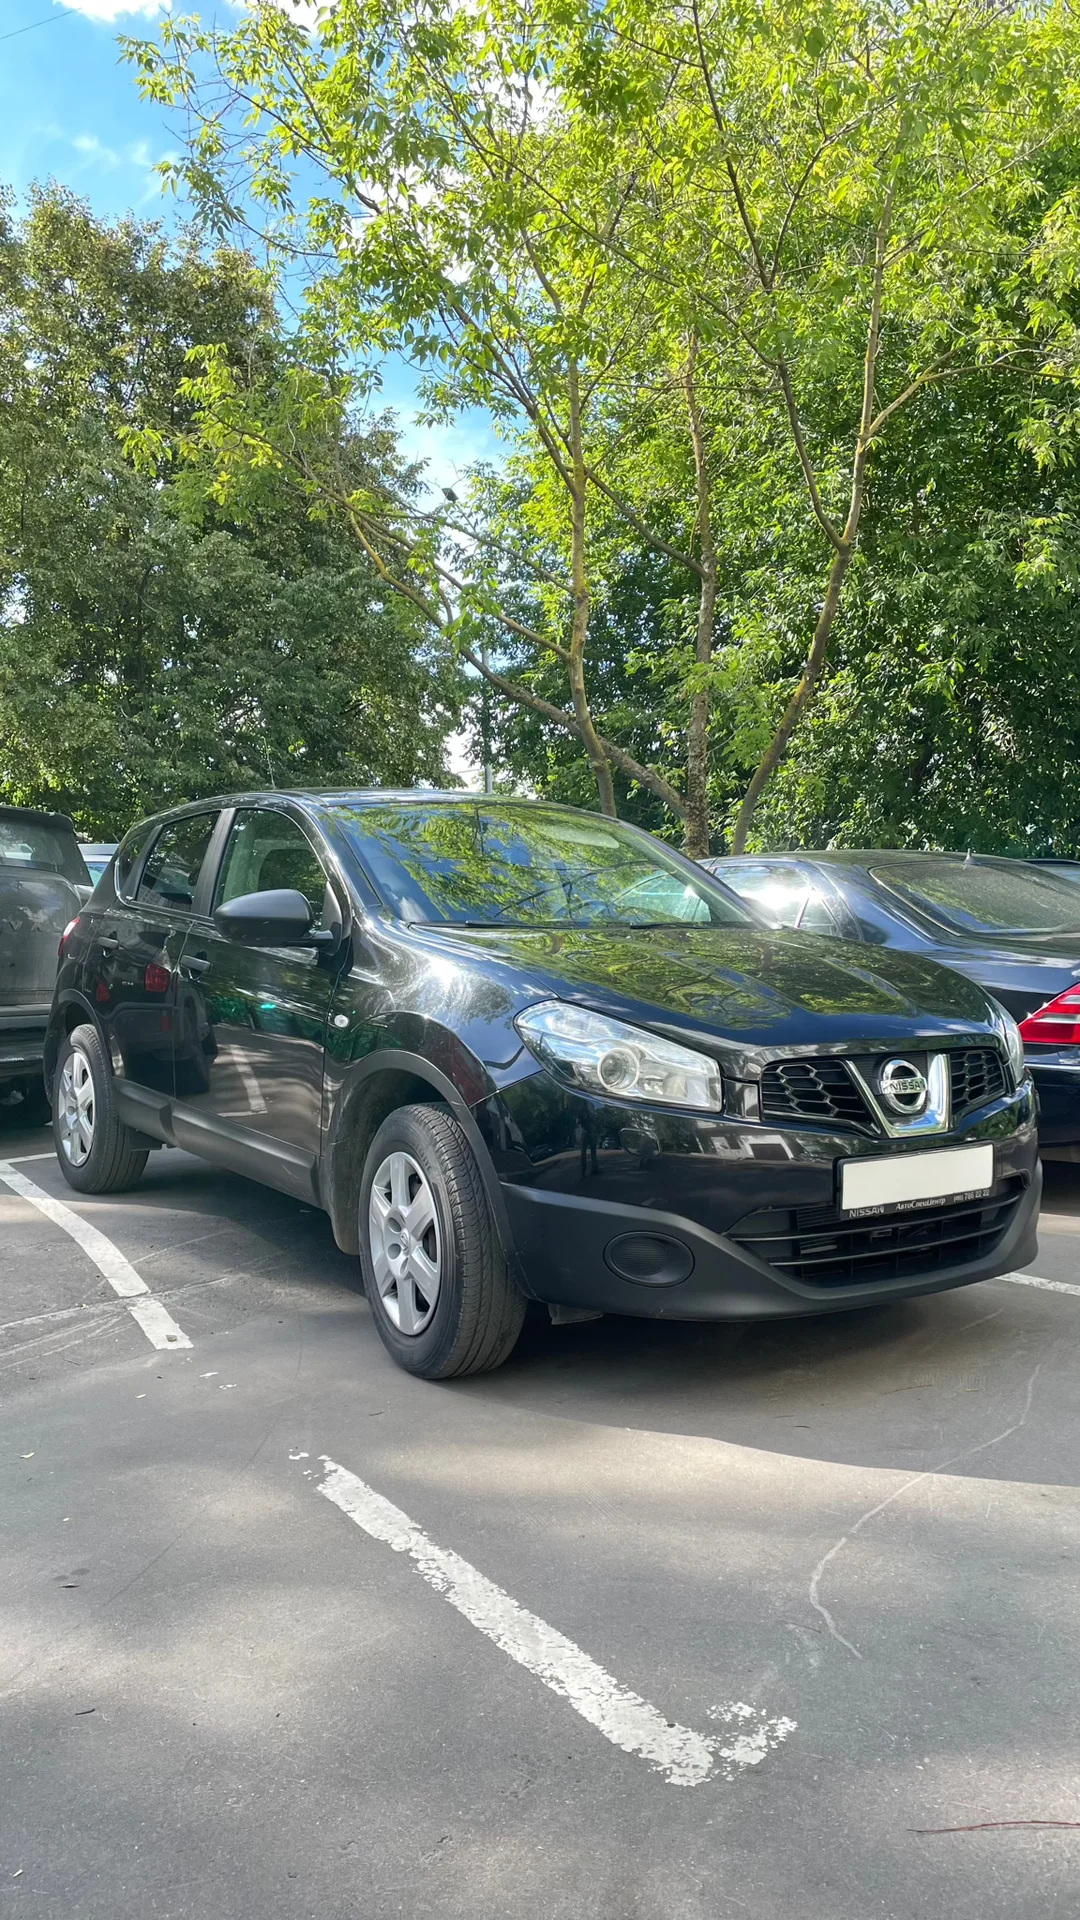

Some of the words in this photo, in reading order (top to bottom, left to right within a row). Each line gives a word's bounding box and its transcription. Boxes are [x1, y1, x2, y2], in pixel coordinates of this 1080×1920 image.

[890, 1080, 926, 1092] NISSAN
[983, 1189, 990, 1197] 22
[849, 1206, 885, 1218] NISSAN
